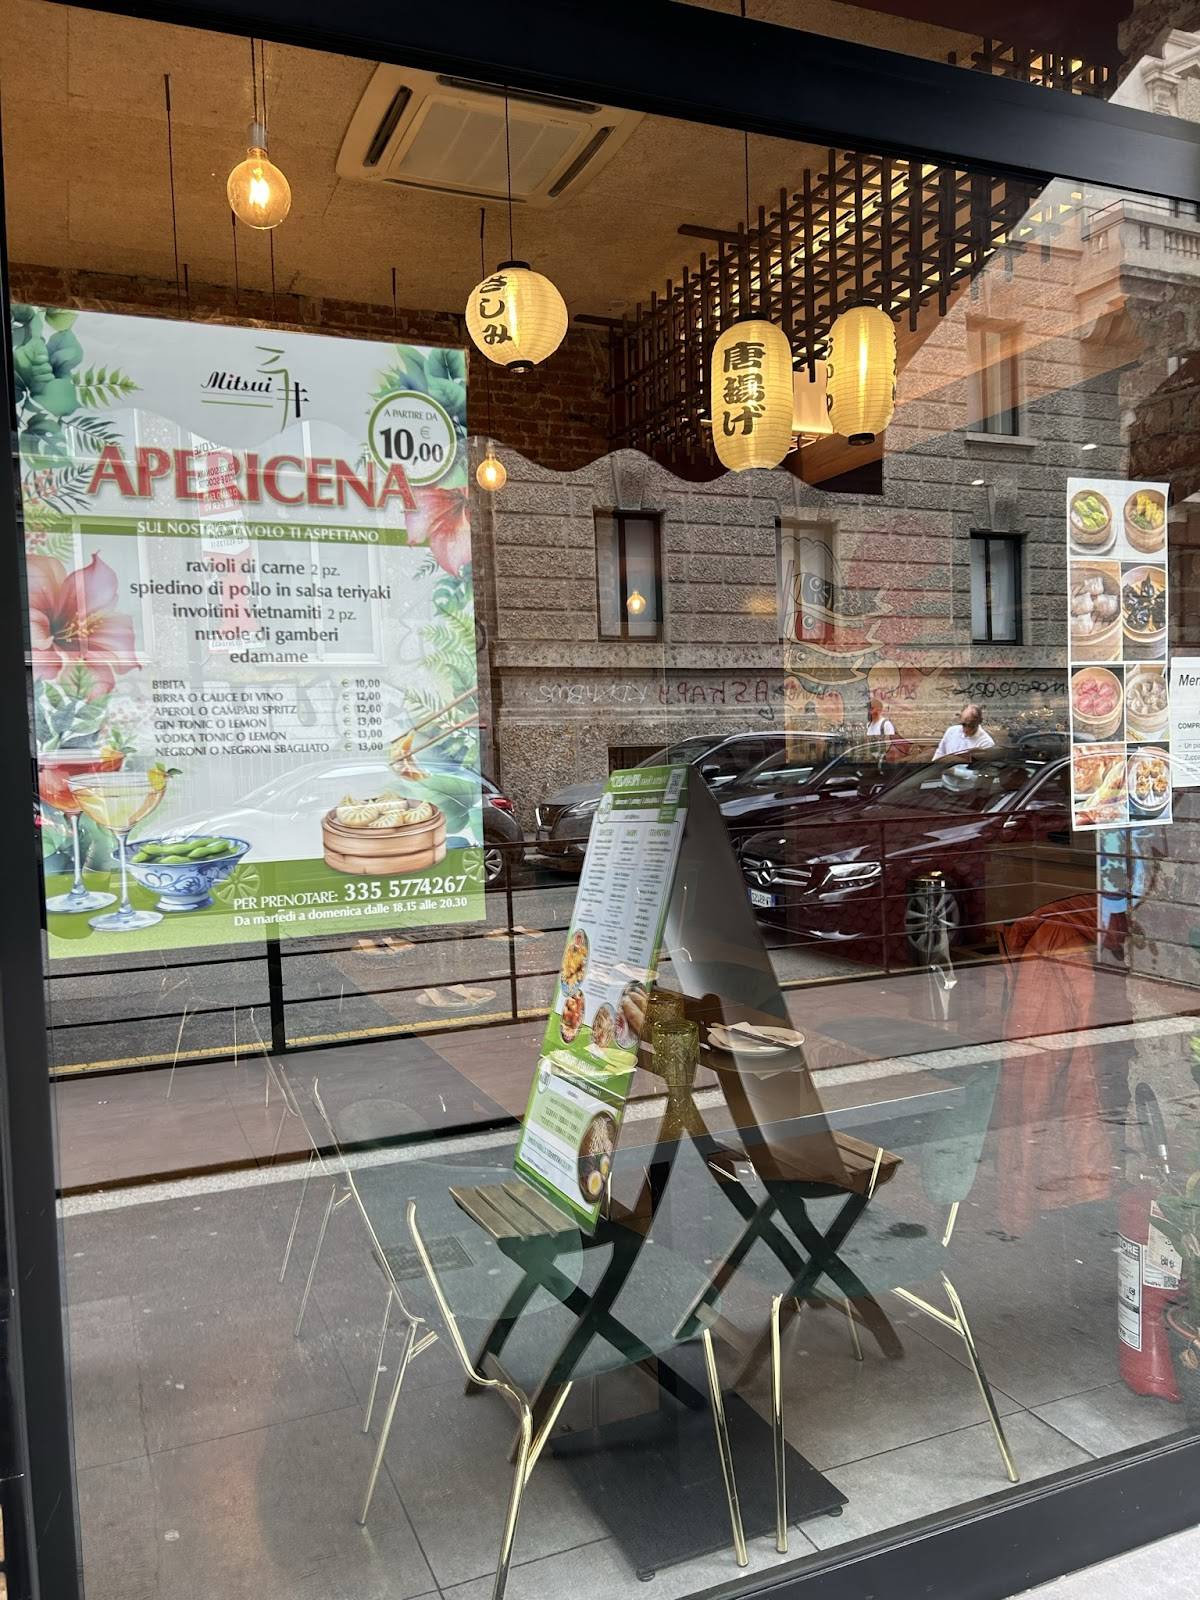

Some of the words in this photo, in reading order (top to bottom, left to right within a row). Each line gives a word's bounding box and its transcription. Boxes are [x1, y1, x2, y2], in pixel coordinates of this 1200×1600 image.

[200, 371, 272, 394] Mitsui
[722, 340, 766, 438] 唐揚げ
[384, 410, 392, 418] A
[393, 410, 424, 421] PARTIRE
[424, 411, 438, 421] DA
[379, 427, 444, 464] 10,00
[86, 444, 418, 513] APERICENA
[137, 520, 169, 534] SUL
[290, 526, 301, 539] TI
[304, 527, 379, 541] ASPETTANO
[186, 558, 236, 574] ravioli
[241, 559, 255, 574] di
[262, 562, 306, 575] carne
[311, 564, 318, 575] 2
[322, 564, 341, 579] pz.
[130, 579, 204, 599] spiedino
[208, 581, 224, 596] di
[229, 582, 272, 599] pollo
[276, 583, 291, 597] in
[296, 584, 334, 599] salsa
[337, 585, 392, 603] teriyaki
[172, 602, 240, 618] involtini
[244, 604, 322, 620] vietnamiti
[327, 609, 335, 620] 2
[338, 610, 357, 624] pz.
[195, 626, 251, 642] nuvole
[255, 626, 271, 642] di
[275, 627, 340, 647] gamberi
[229, 648, 310, 665] edamame
[152, 680, 186, 690] BIBITA
[355, 679, 381, 689] 10,00
[152, 693, 186, 704] BIRRA
[188, 693, 198, 702] O
[200, 692, 239, 703] CALICE
[241, 692, 253, 702] DI
[255, 691, 284, 702] VINO
[356, 692, 382, 702] 12,00
[154, 705, 196, 717] APEROL
[198, 706, 209, 716] O
[211, 705, 259, 716] CAMPARI
[262, 704, 298, 715] SPRITZ
[356, 704, 382, 715] 12,00
[154, 719, 176, 731] GIN
[178, 719, 213, 731] TONIC
[216, 718, 226, 729] O
[228, 718, 267, 729] LEMON
[357, 717, 383, 727] 13,00
[154, 732, 196, 744] VODKA
[199, 732, 234, 743] TONIC
[235, 731, 246, 742] O
[249, 731, 287, 742] LEMON
[357, 729, 383, 740] 13,00
[155, 746, 207, 758] NEGRONI
[209, 746, 219, 756] O
[222, 745, 273, 756] NEGRONI
[274, 743, 330, 754] SBAGLIATO
[358, 742, 384, 753] 13,00
[233, 896, 257, 911] PER
[260, 891, 339, 909] PRENOTARE:
[343, 881, 383, 903] 335
[388, 875, 468, 899] 5774267
[234, 914, 251, 927] Da
[298, 911, 306, 921] a
[308, 905, 362, 921] domenica
[364, 903, 391, 915] dalle
[392, 901, 418, 913] 18.15
[419, 898, 439, 911] alle
[439, 896, 469, 910] 20.30
